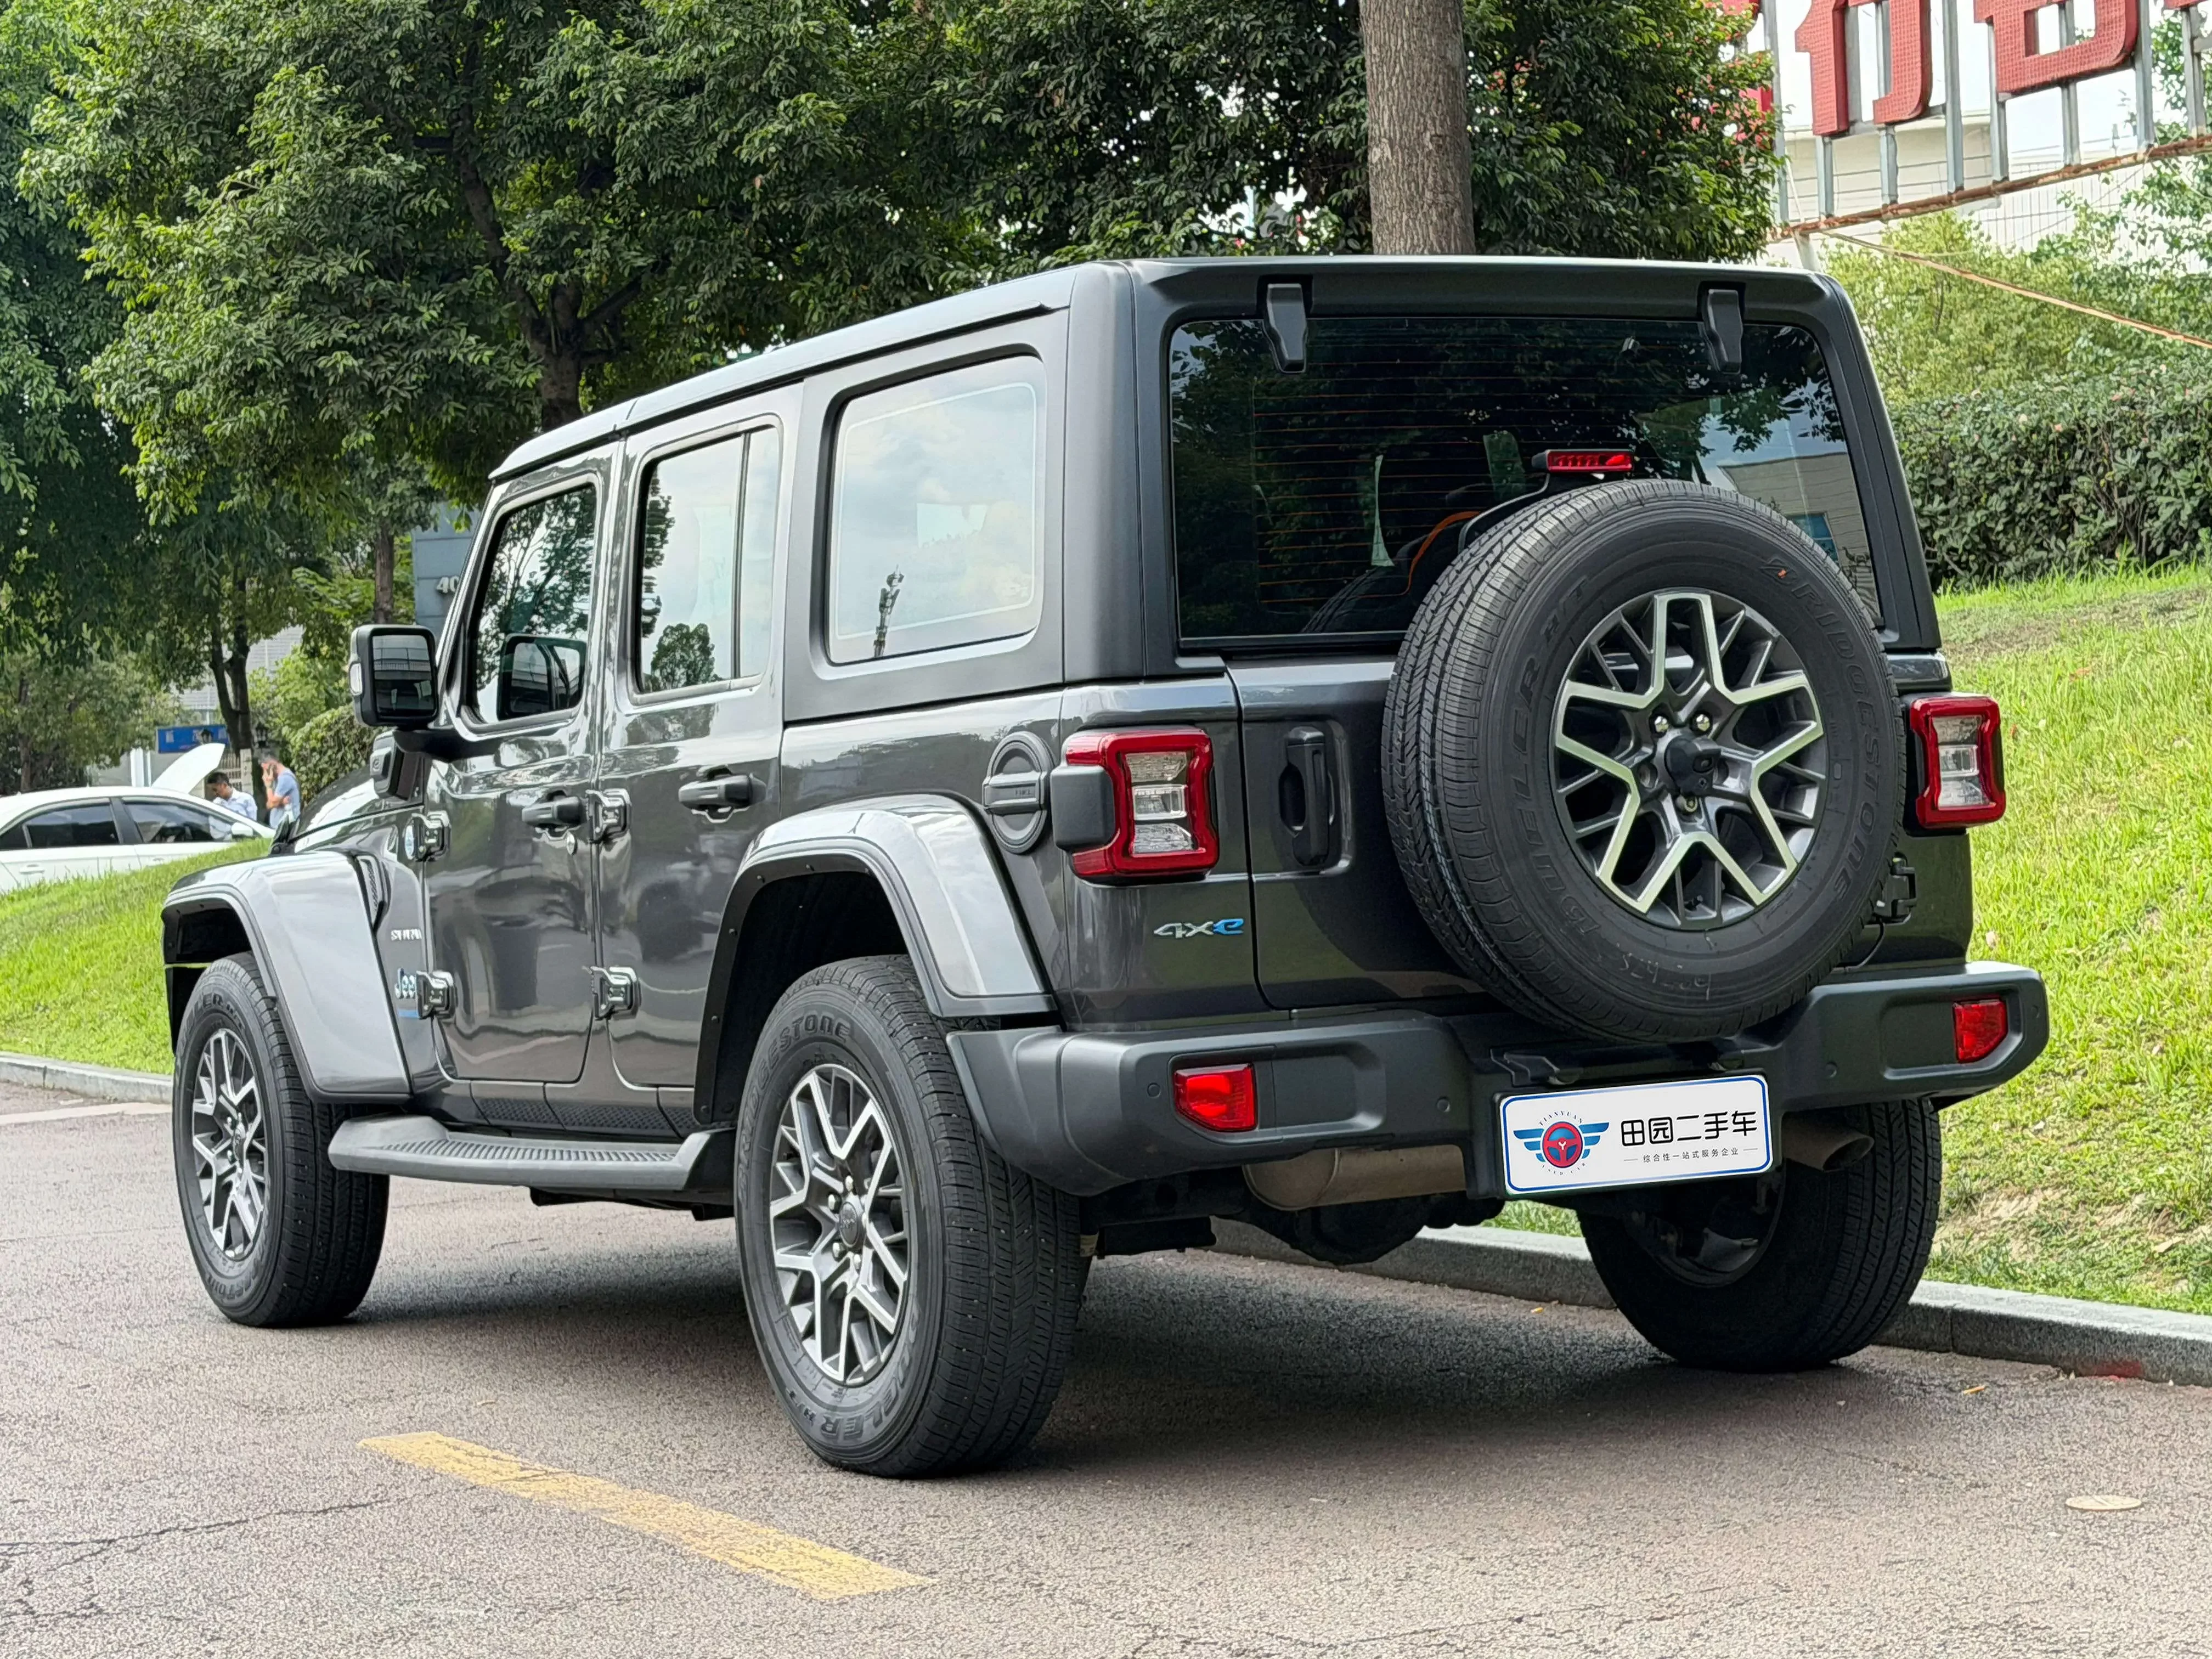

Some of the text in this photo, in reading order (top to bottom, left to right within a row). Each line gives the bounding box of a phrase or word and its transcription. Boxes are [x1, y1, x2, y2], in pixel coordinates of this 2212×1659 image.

[1760, 555, 1881, 900] BRIDGESTONE
[1512, 657, 1600, 934] DUELER
[394, 968, 417, 999] Jee
[737, 1014, 853, 1207] BRIDGESTONE
[1621, 1110, 1757, 1147] 田园二手车
[1642, 1147, 1739, 1163] 综合性一站式服务企业
